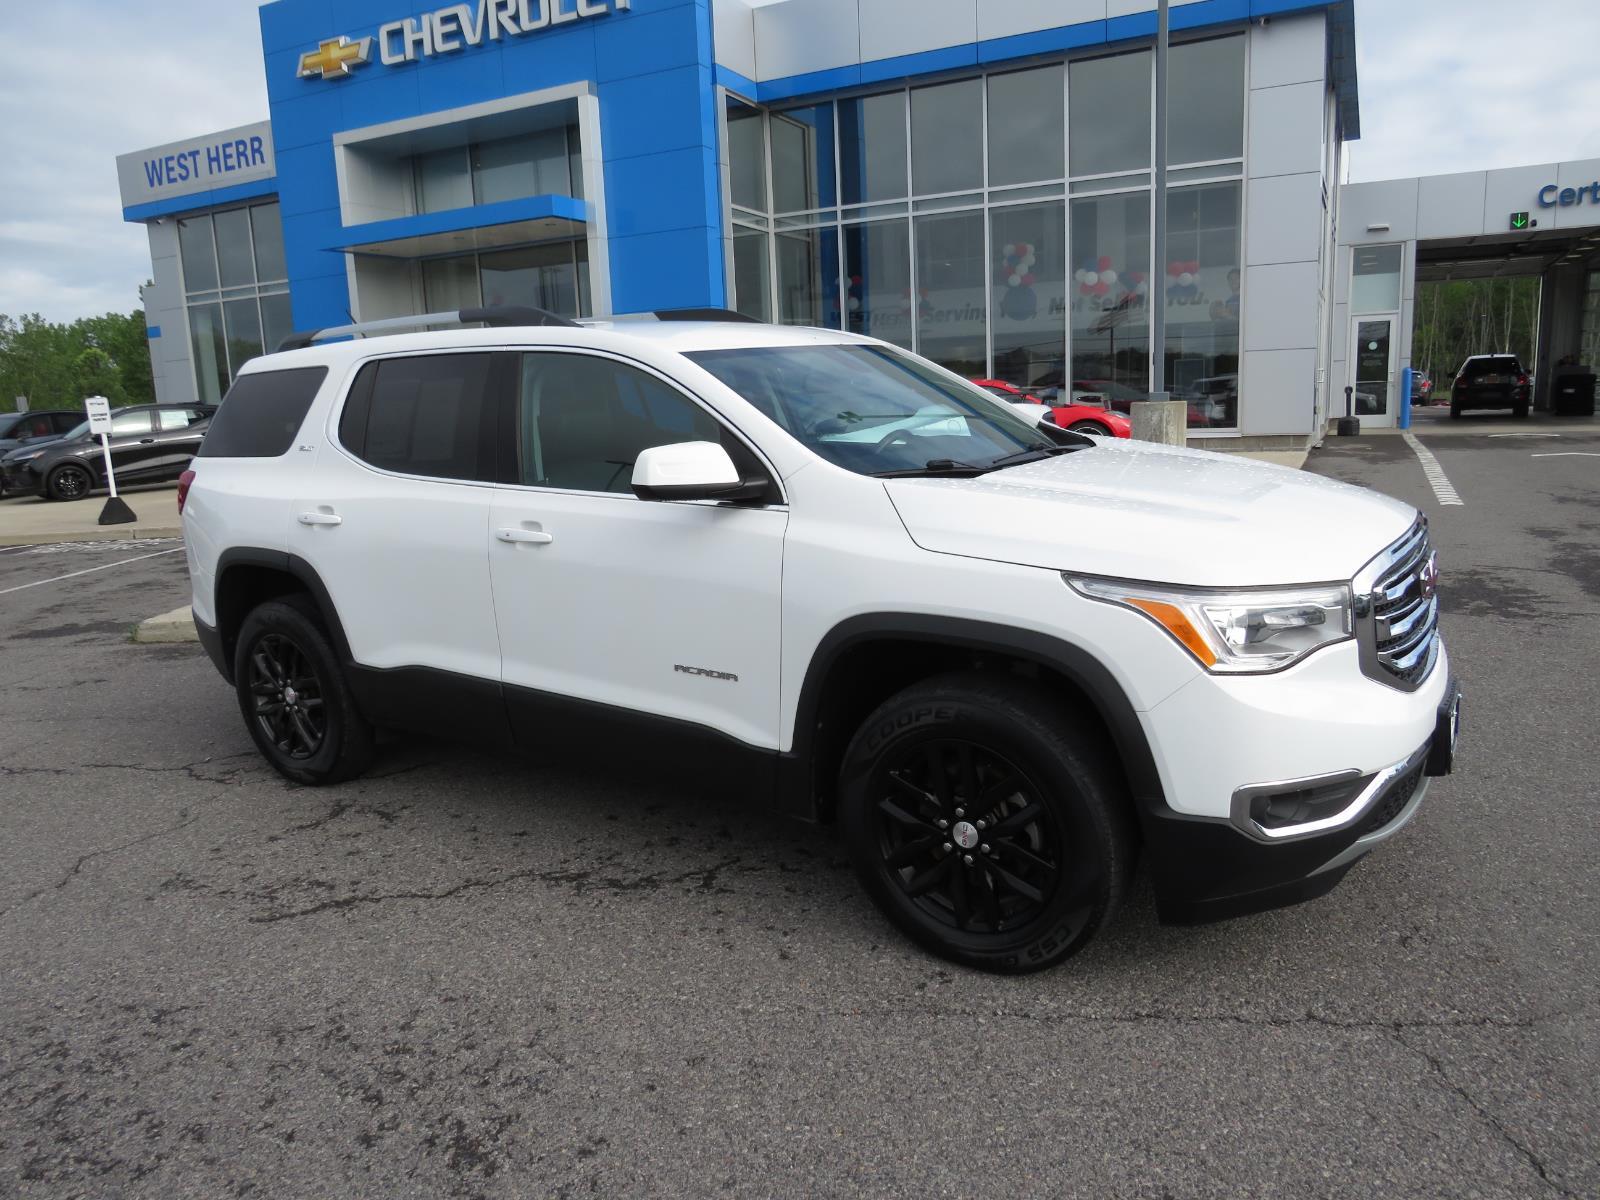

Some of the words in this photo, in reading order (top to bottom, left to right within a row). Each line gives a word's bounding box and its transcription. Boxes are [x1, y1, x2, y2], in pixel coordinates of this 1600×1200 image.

[379, 0, 632, 66] CHEVROL
[144, 150, 200, 188] WEST
[206, 136, 266, 175] HERR
[1538, 181, 1600, 208] Cert
[674, 664, 738, 682] ACADIA
[865, 705, 974, 752] COOPER
[961, 824, 969, 846] GMC
